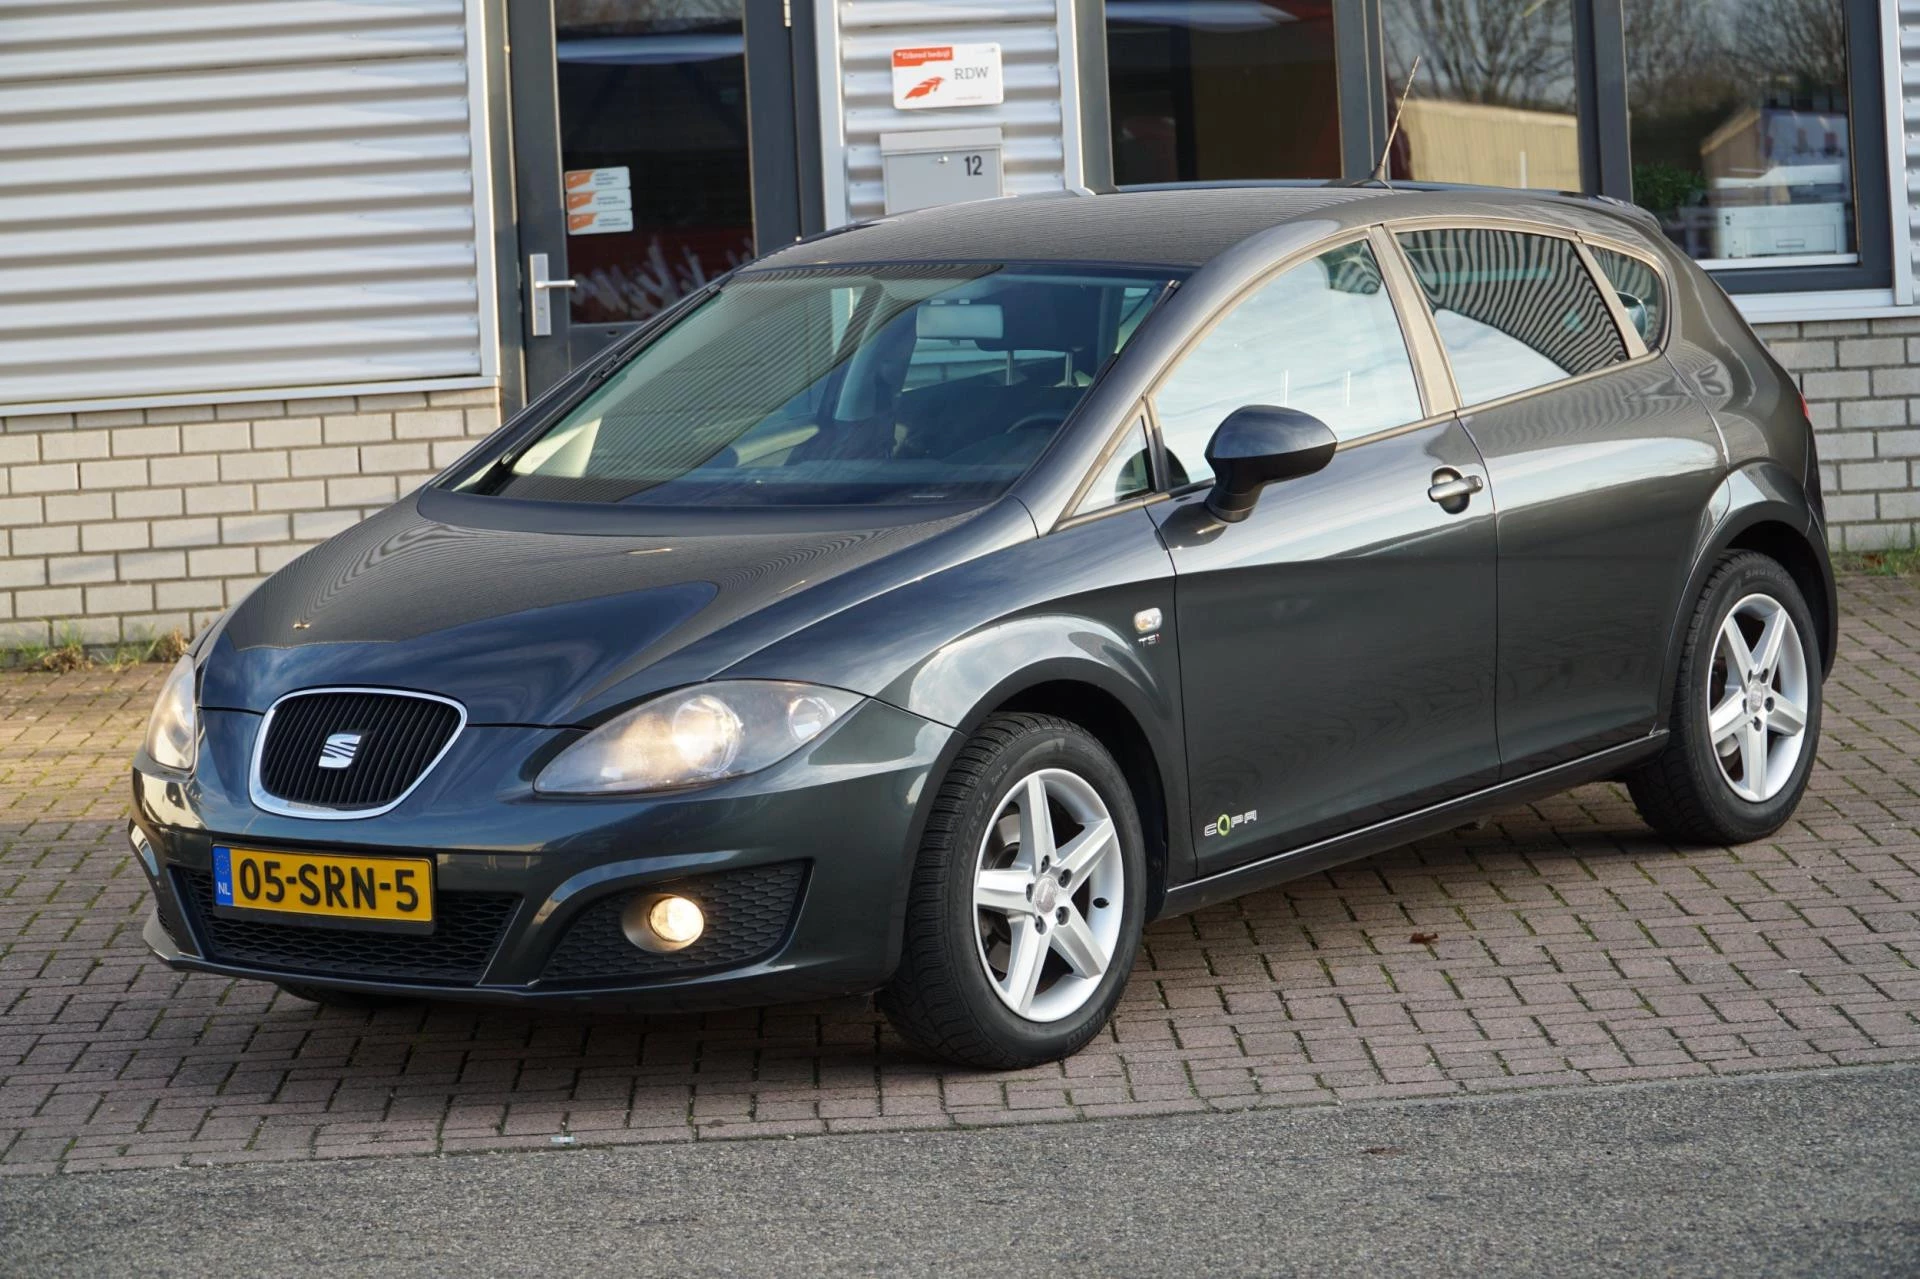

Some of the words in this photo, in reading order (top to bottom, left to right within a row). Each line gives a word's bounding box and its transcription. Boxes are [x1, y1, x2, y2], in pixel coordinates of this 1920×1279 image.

[954, 66, 989, 80] RDW
[964, 155, 983, 177] 12
[217, 881, 231, 896] NL
[239, 858, 418, 912] 05-SRN-5
